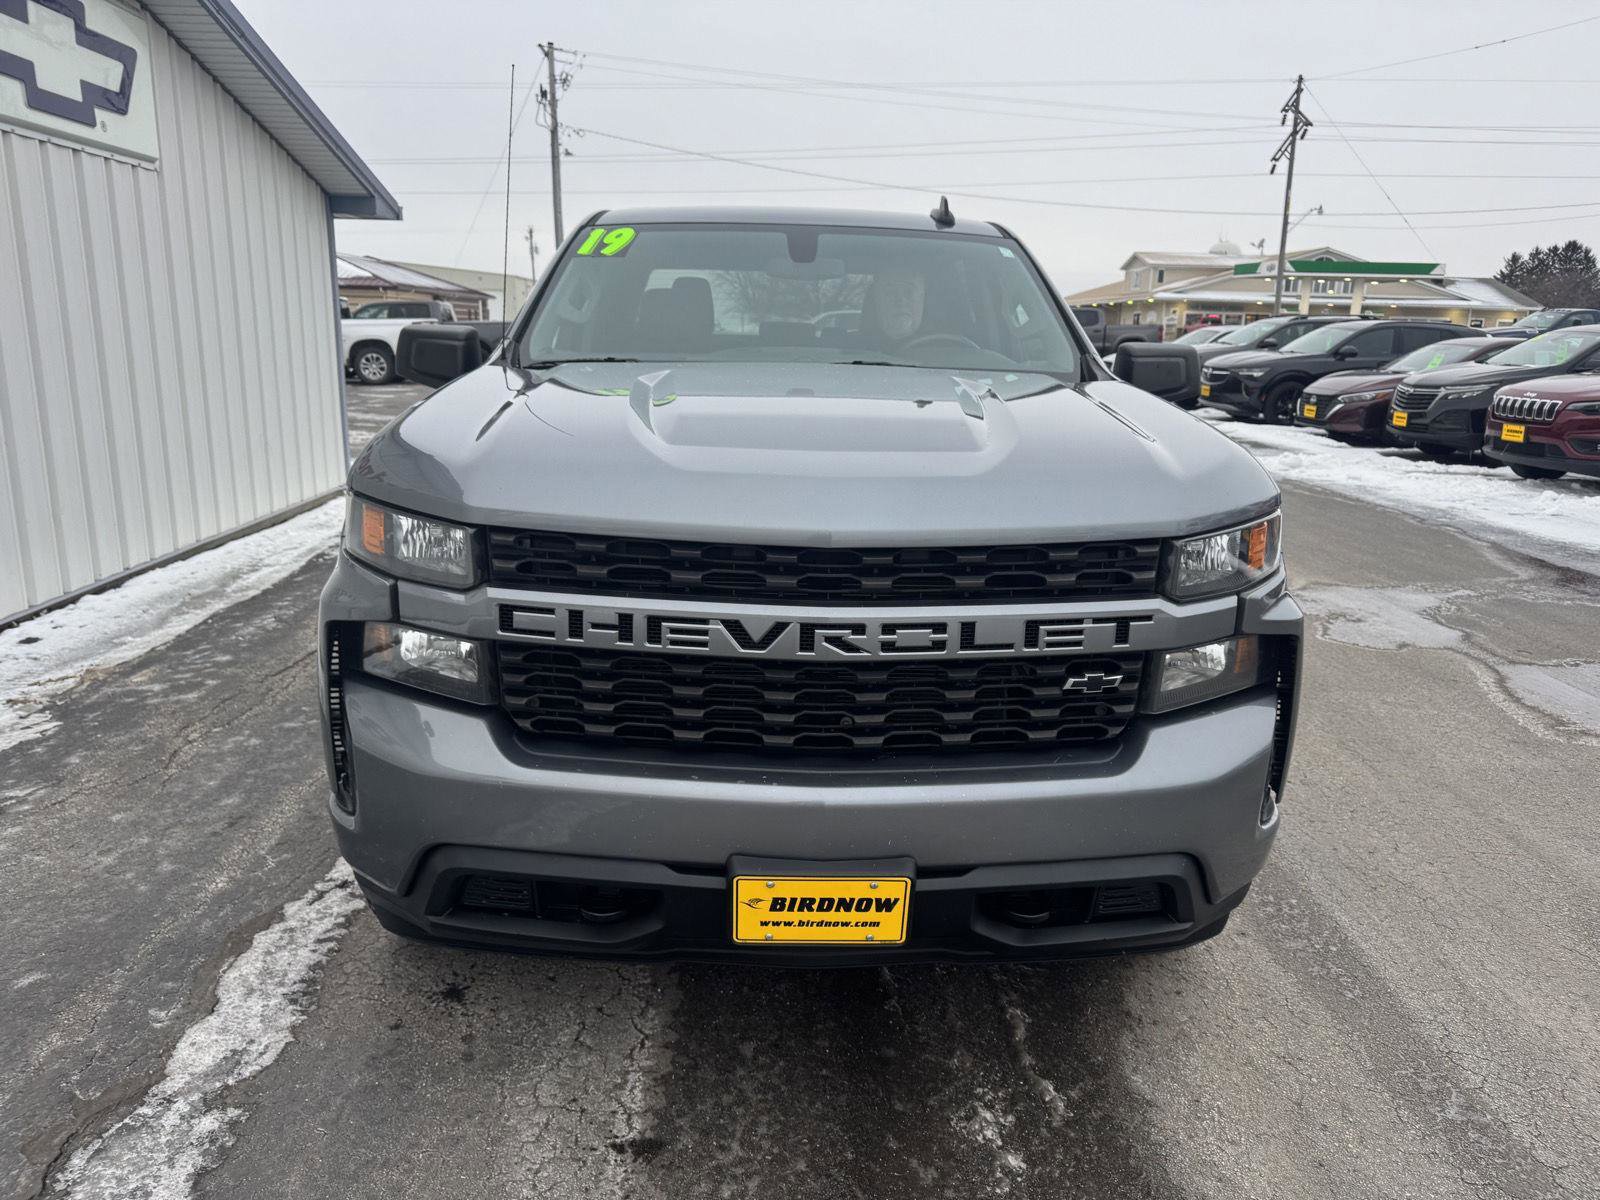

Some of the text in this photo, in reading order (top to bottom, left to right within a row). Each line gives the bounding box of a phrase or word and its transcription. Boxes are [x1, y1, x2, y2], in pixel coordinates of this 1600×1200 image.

[577, 227, 636, 256] 19
[496, 603, 1154, 656] CHEVROLET
[769, 897, 900, 912] BIRDNOW
[759, 919, 881, 928] www.birdnow.com
